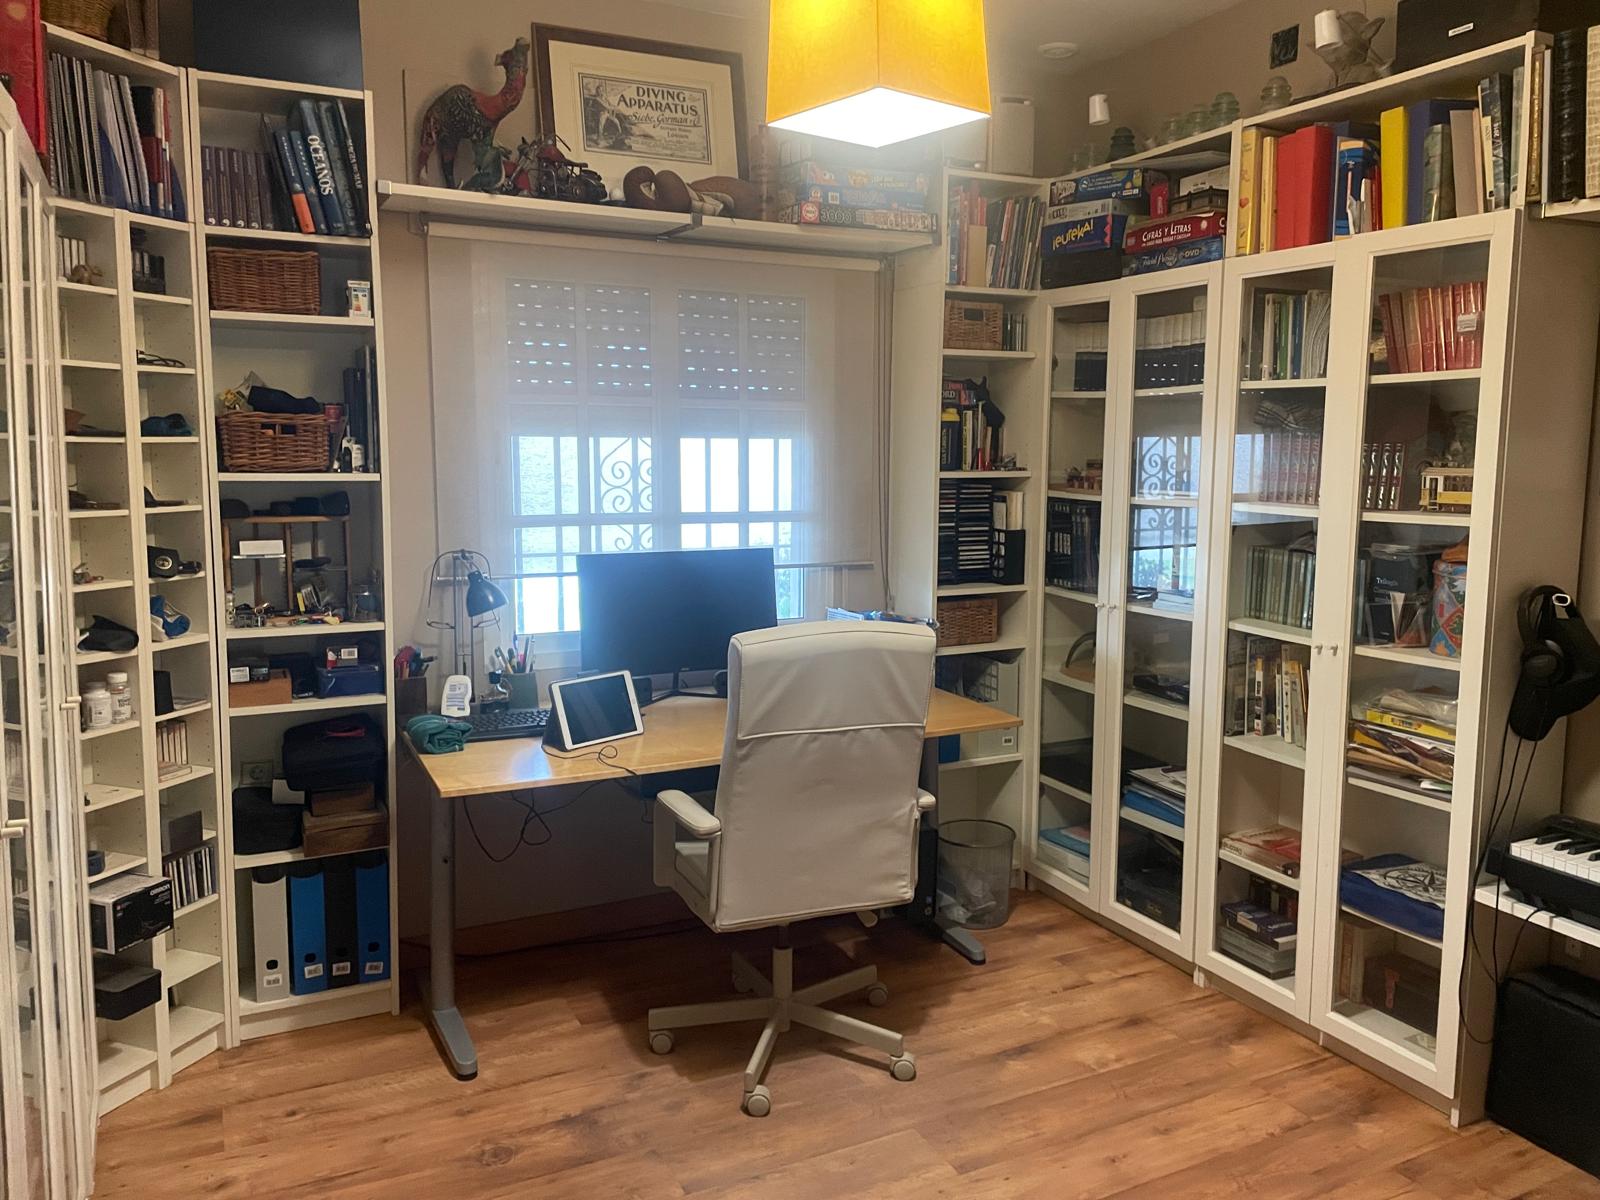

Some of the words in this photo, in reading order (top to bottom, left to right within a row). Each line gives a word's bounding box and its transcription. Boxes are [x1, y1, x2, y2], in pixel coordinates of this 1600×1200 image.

[636, 86, 686, 103] DIVING
[617, 94, 698, 116] APPARATUS
[307, 135, 334, 195] OCEANOS
[1142, 229, 1162, 242] CIFRAS
[1164, 226, 1168, 235] Y
[1170, 223, 1191, 235] LETRAS
